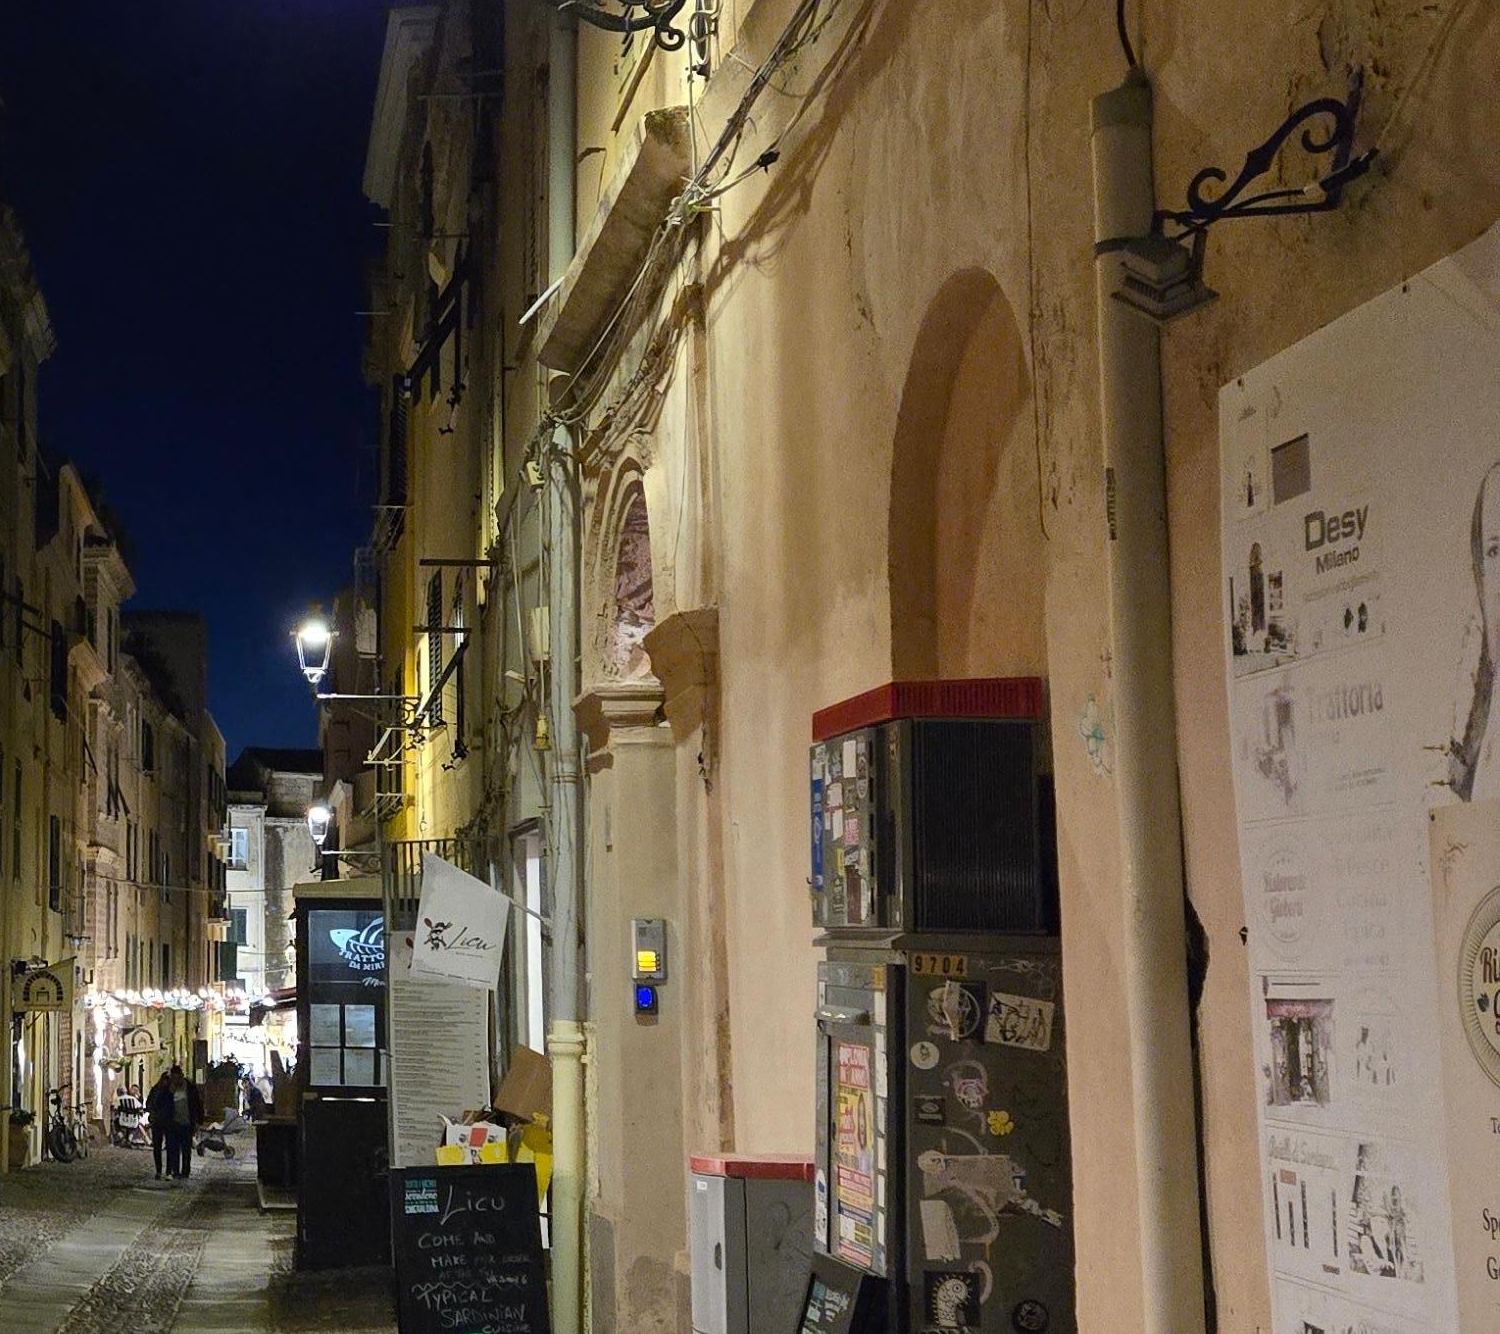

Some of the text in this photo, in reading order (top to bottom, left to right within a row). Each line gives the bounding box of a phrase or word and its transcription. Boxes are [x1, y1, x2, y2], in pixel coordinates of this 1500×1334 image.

[1304, 505, 1369, 552] Desy
[1315, 546, 1360, 575] Milano
[914, 955, 965, 975] 9704
[418, 1232, 465, 1249] COME
[431, 1254, 467, 1267] MAKE
[417, 1288, 493, 1310] TYPICAL
[441, 1304, 525, 1328] SARDINIAN
